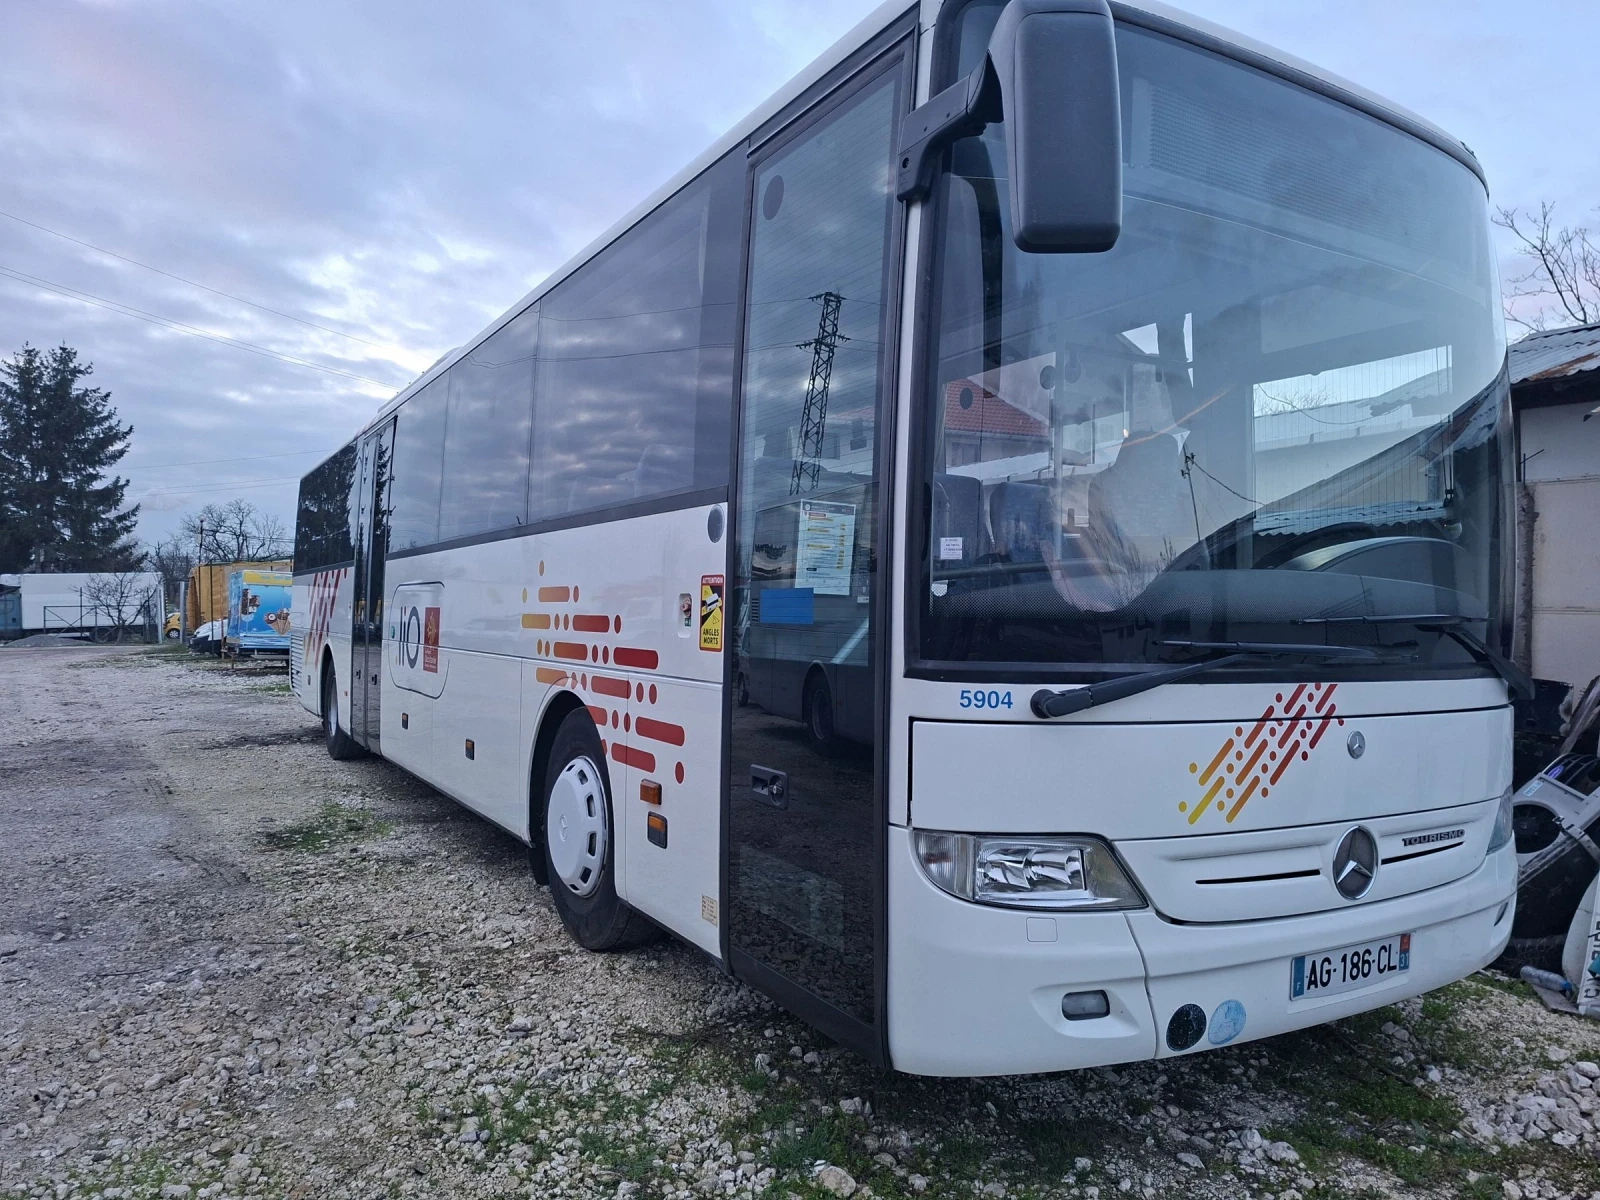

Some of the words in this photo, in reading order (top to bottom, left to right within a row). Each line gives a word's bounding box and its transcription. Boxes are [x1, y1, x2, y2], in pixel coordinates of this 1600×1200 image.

[703, 628, 720, 637] ANGLES
[703, 637, 719, 645] MORTS
[960, 690, 1013, 709] 5904
[1402, 829, 1465, 847] TOURISMO
[1400, 953, 1410, 967] 31
